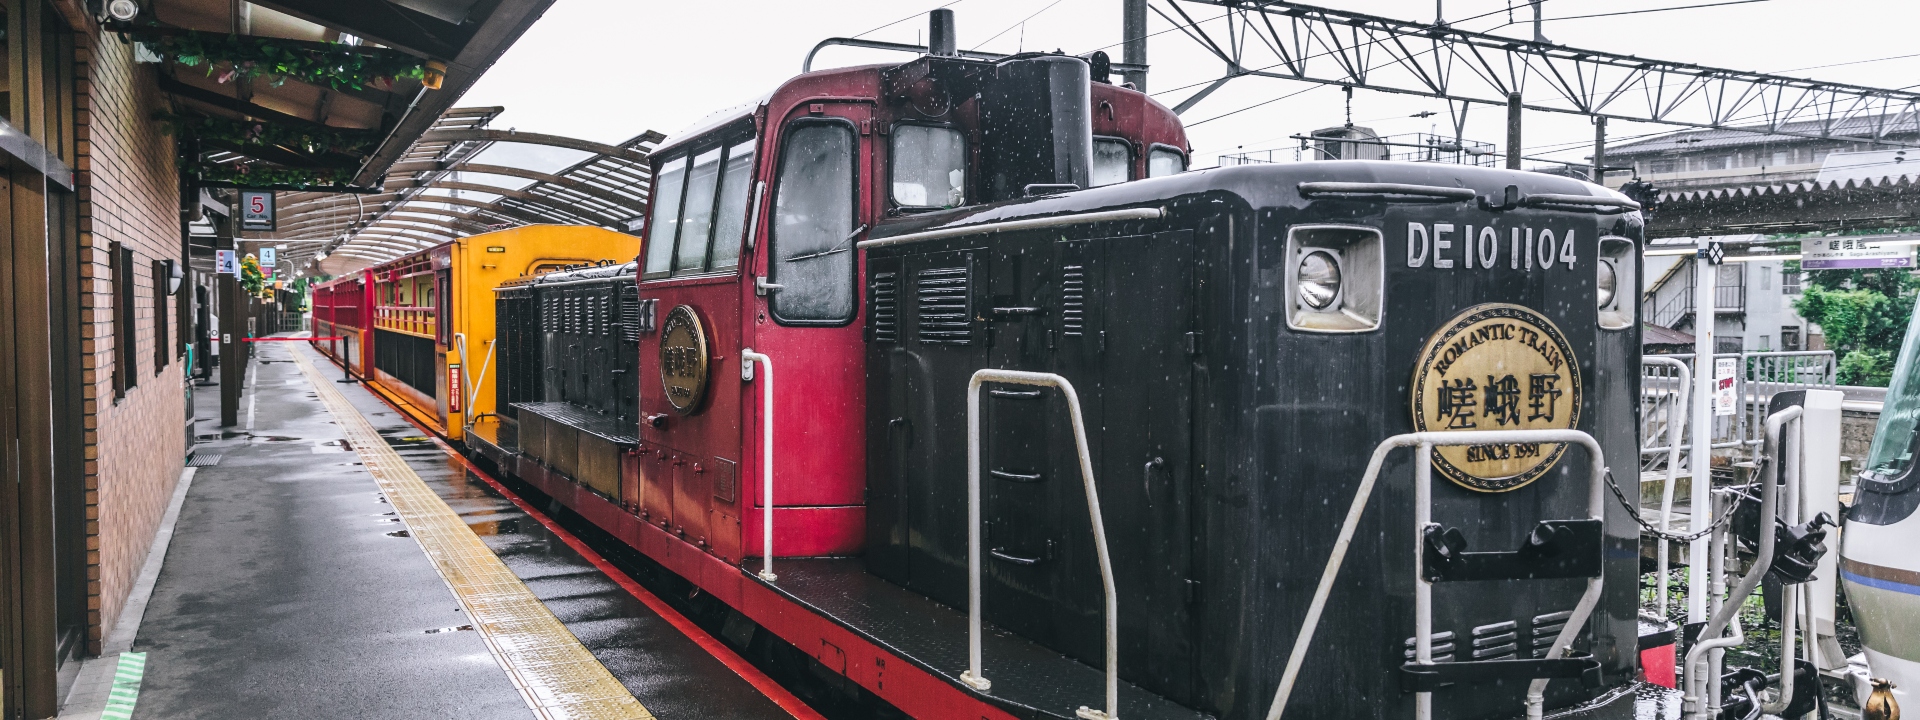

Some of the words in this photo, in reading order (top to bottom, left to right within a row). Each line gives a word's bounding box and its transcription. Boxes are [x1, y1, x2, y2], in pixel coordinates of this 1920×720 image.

[251, 196, 264, 214] 5
[264, 250, 270, 258] 4
[1510, 227, 1577, 271] 1104
[225, 260, 233, 269] 4
[1433, 324, 1515, 378] ROMANTIC
[1518, 326, 1564, 372] TRAIN
[1436, 373, 1563, 430] 嵯峨野
[1467, 443, 1510, 463] SINCE
[1514, 442, 1540, 459] 1991
